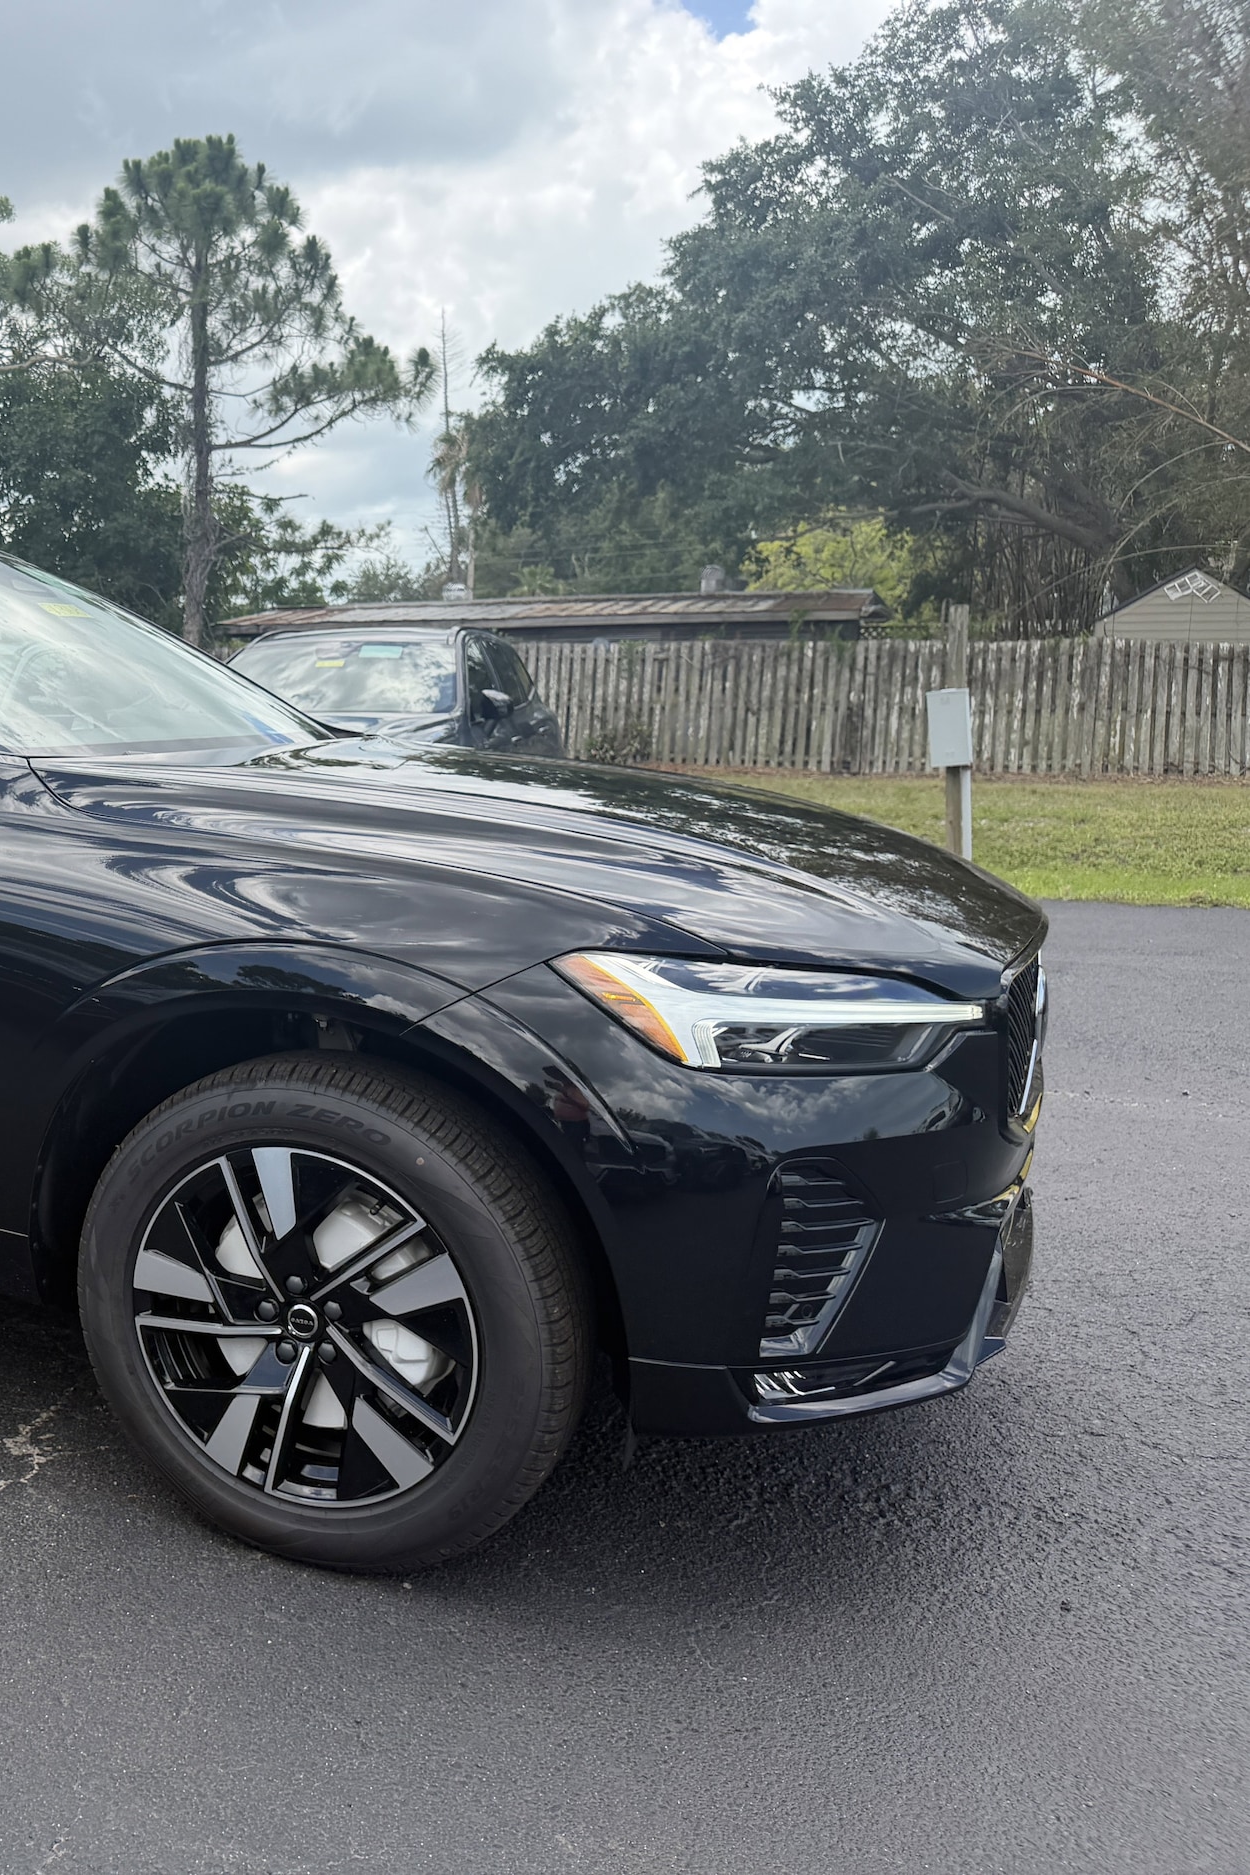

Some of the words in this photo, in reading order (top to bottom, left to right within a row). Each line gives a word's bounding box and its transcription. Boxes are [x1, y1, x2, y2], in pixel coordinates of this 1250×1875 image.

[127, 1101, 276, 1184] SCORPION
[286, 1103, 391, 1146] ZERO
[290, 1317, 314, 1326] VOLVO
